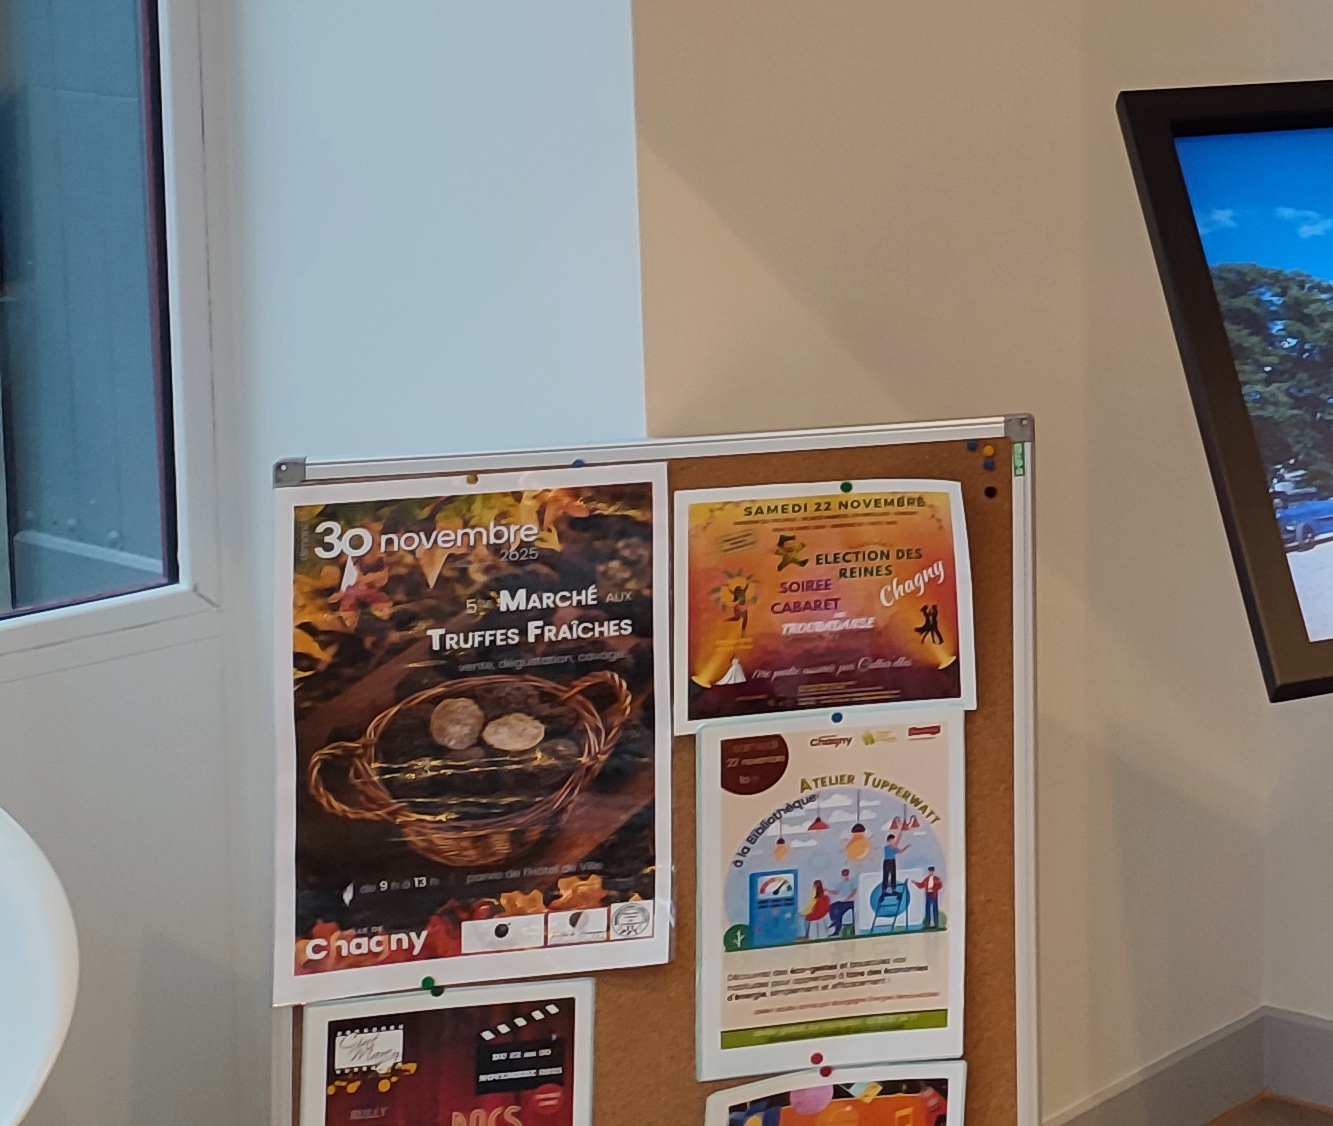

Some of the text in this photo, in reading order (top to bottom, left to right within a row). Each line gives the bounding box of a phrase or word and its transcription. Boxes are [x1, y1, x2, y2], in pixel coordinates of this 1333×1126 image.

[743, 495, 926, 517] SAMEDI 22 NOVEMBRE
[314, 520, 373, 559] 30
[380, 521, 538, 553] novembre
[815, 548, 923, 565] ELECTION DES
[838, 564, 893, 580] REINES
[879, 558, 945, 608] Chagny
[770, 597, 842, 615] CABARET
[426, 627, 520, 652] TRUFFES
[800, 772, 941, 825] ATELIER TUPPERWATT
[737, 845, 751, 860] la
[748, 793, 817, 847] Bibliothèque
[379, 879, 388, 892] 9
[413, 876, 427, 888] 13
